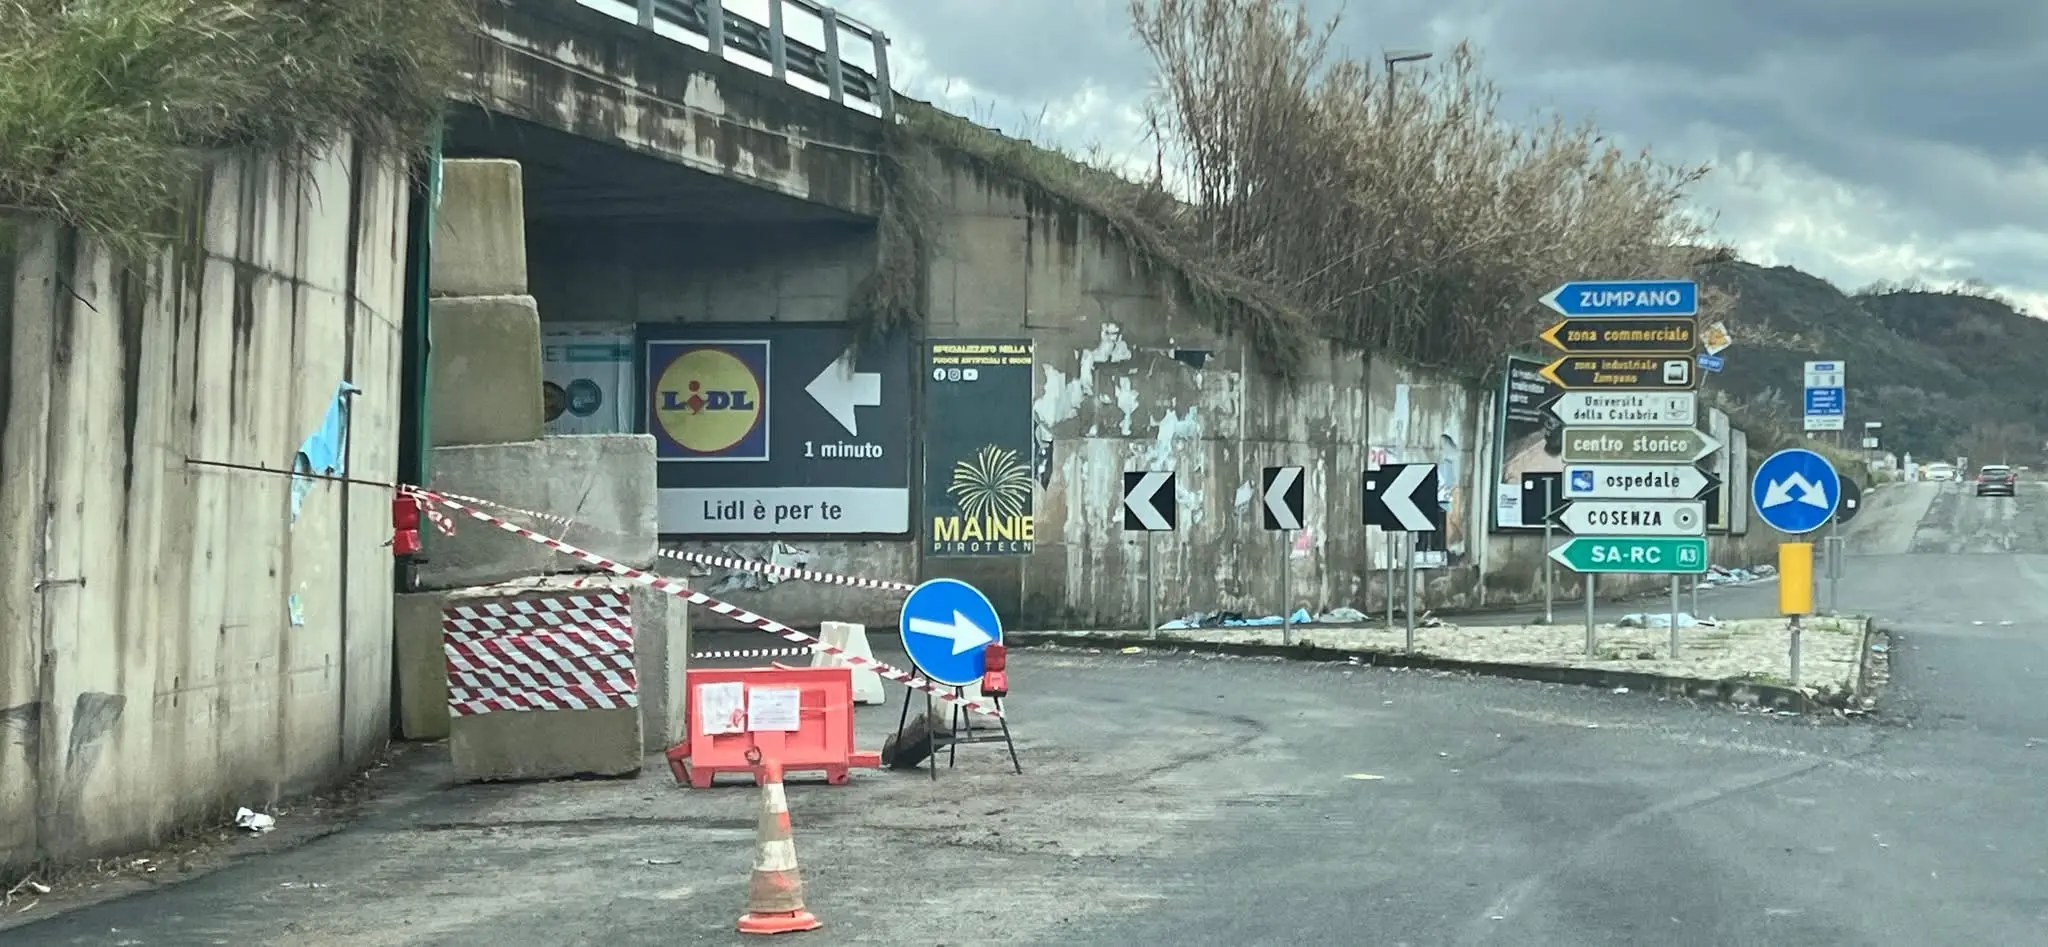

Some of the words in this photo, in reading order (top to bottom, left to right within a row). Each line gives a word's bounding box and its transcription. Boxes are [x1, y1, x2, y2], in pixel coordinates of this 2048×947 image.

[1579, 290, 1681, 308] ZUMPANO
[1567, 328, 1597, 342] zona
[1603, 326, 1689, 342] commerciale
[1602, 359, 1658, 371] industriale
[1593, 371, 1638, 385] Zumpano
[1574, 408, 1603, 420] della
[1609, 408, 1659, 420] Calabria
[804, 441, 814, 457] 1
[821, 440, 883, 458] minuto
[1573, 435, 1623, 452] centro
[1632, 435, 1688, 452] storico
[1606, 472, 1680, 491] ospedale
[703, 500, 745, 520] Lidl
[753, 500, 767, 520] è
[775, 504, 814, 525] per
[820, 501, 843, 520] te
[1588, 510, 1662, 526] COSENZA
[933, 541, 1032, 552] PIROTECN
[1591, 545, 1662, 564] SA-RC
[1679, 550, 1697, 562] A3
